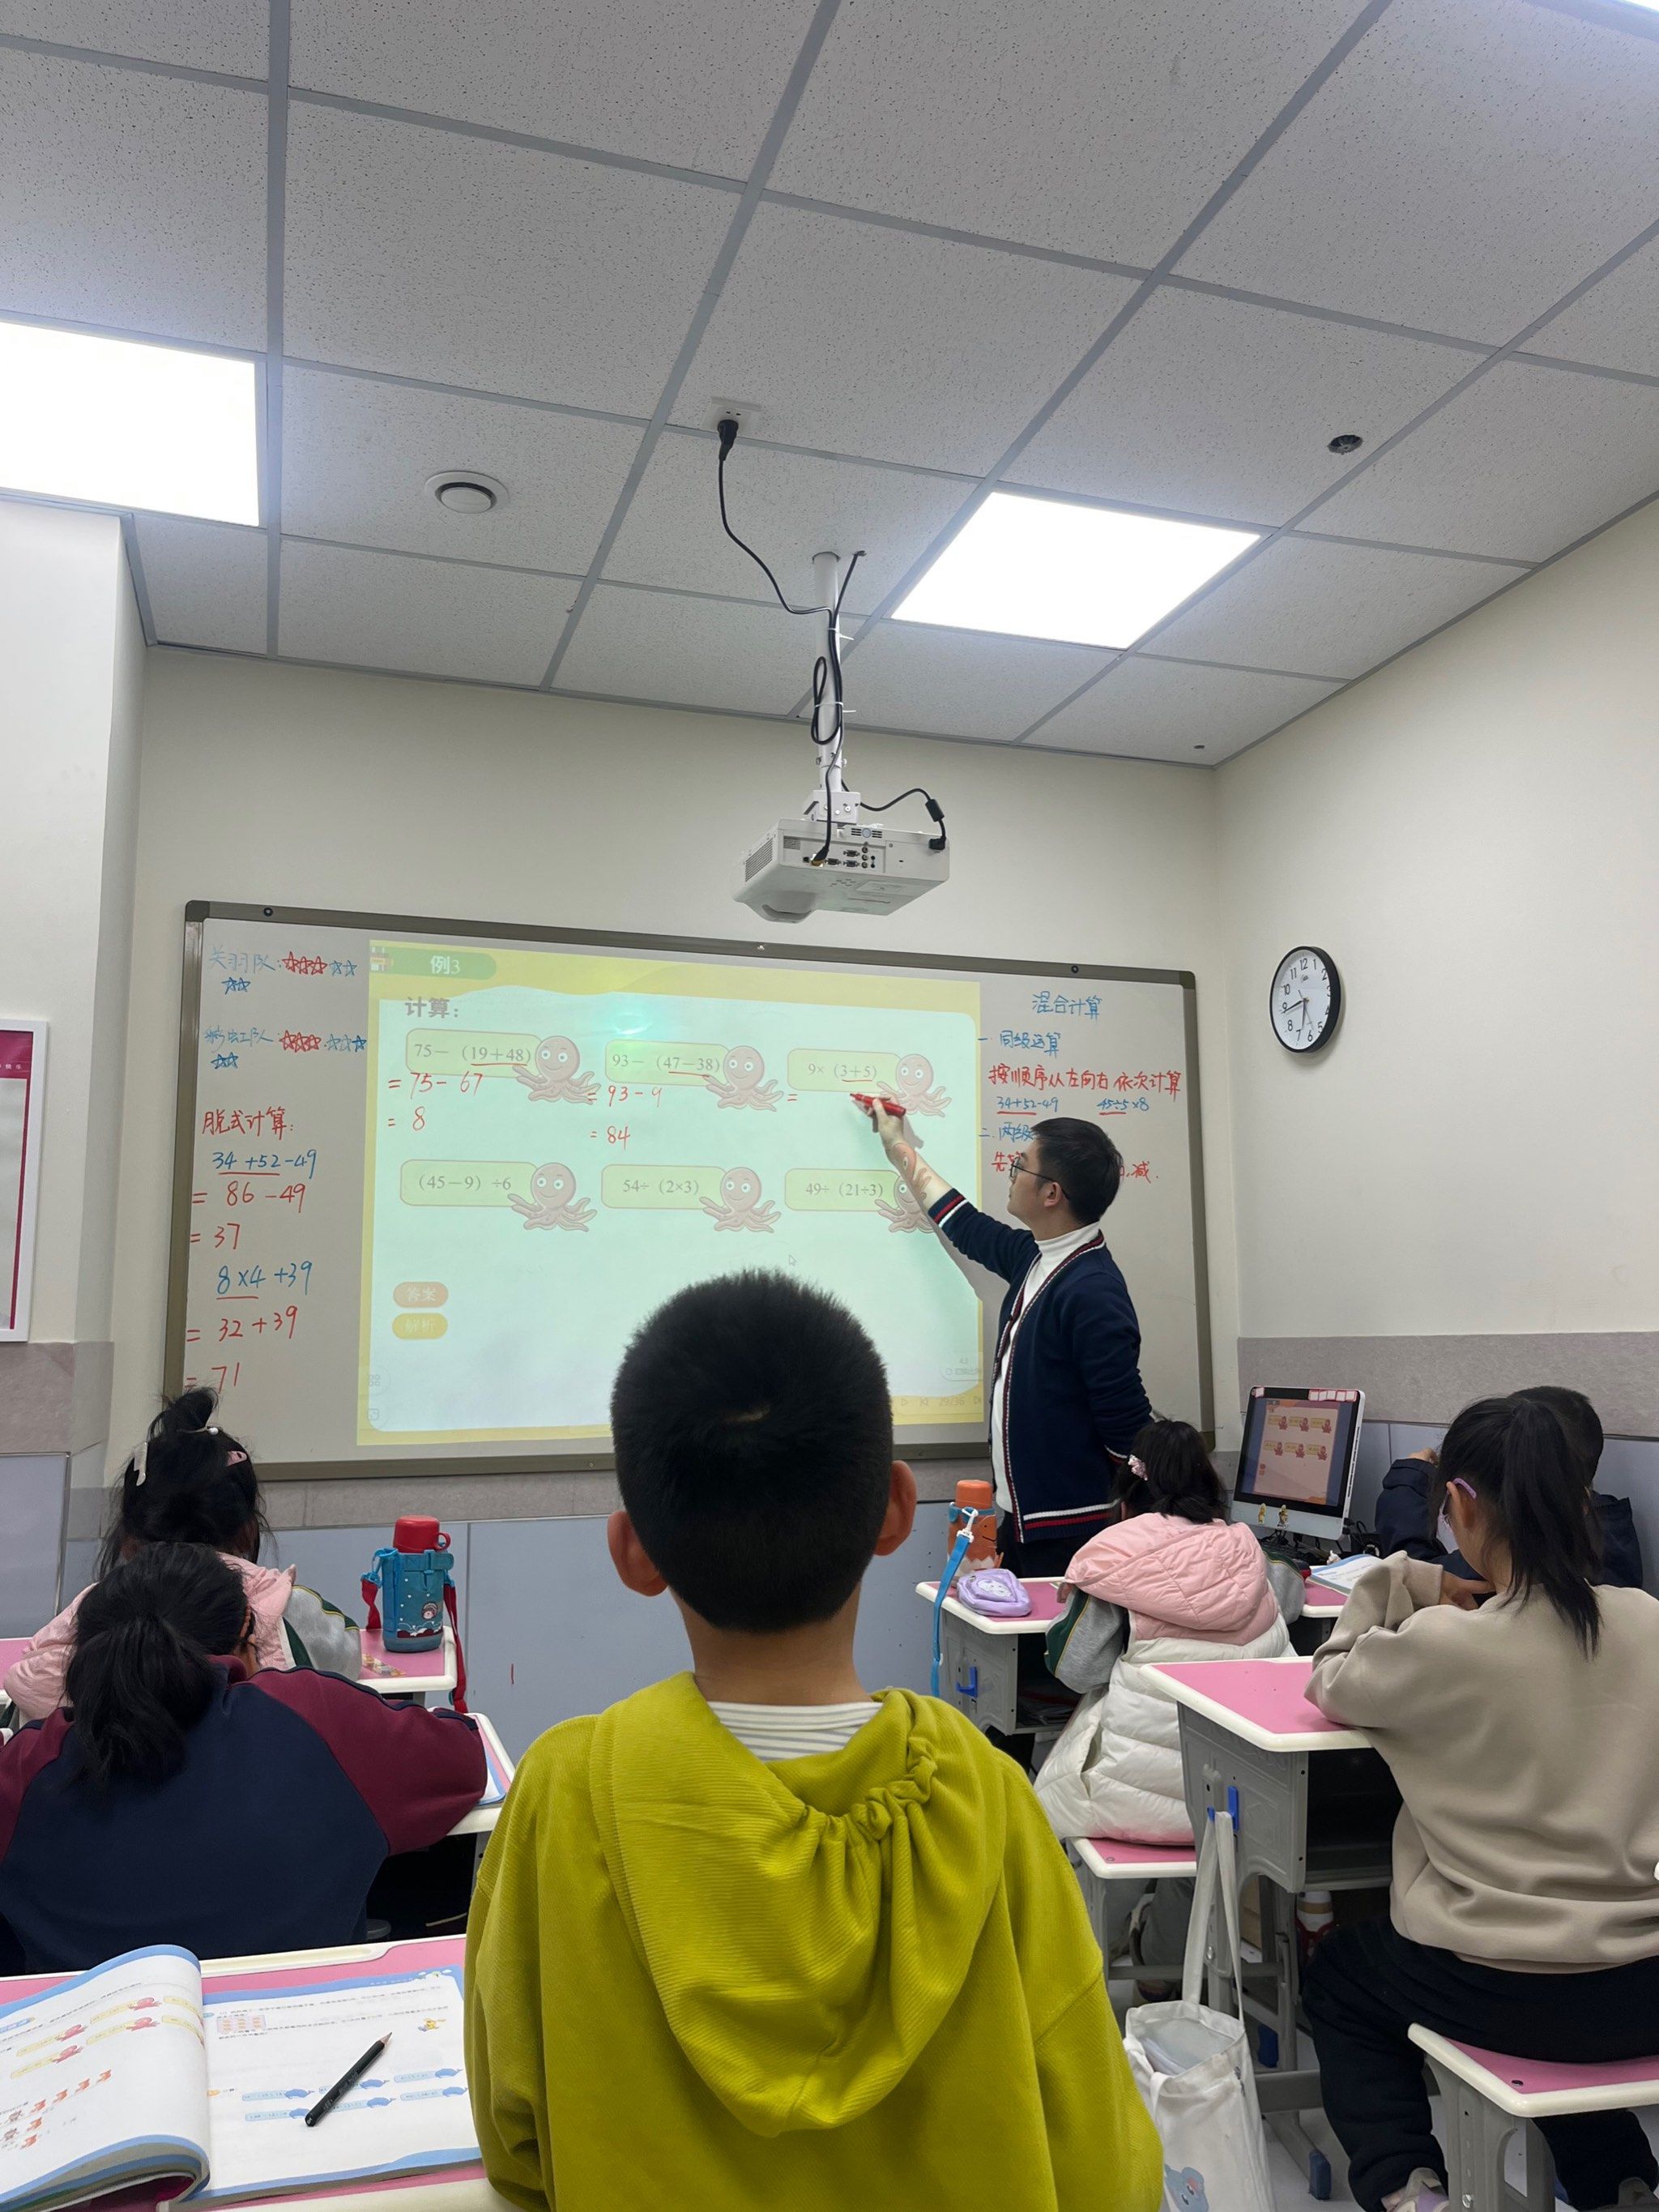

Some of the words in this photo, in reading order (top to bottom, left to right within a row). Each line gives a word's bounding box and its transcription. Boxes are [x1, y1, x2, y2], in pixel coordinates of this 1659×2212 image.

[430, 955, 461, 974] 例3
[1300, 958, 1308, 971] 12
[1313, 959, 1317, 971] 1
[1290, 967, 1297, 980] 11
[1321, 968, 1328, 980] 2
[1284, 984, 1290, 995] 10
[405, 997, 459, 1018] 计算:
[1031, 990, 1102, 1021] 混合计算
[1287, 1019, 1294, 1031] 8
[1295, 1029, 1302, 1042] 7
[1307, 1030, 1313, 1042] 6
[996, 1096, 1059, 1113] 34+52-49
[202, 1106, 294, 1141] 脱式计算:
